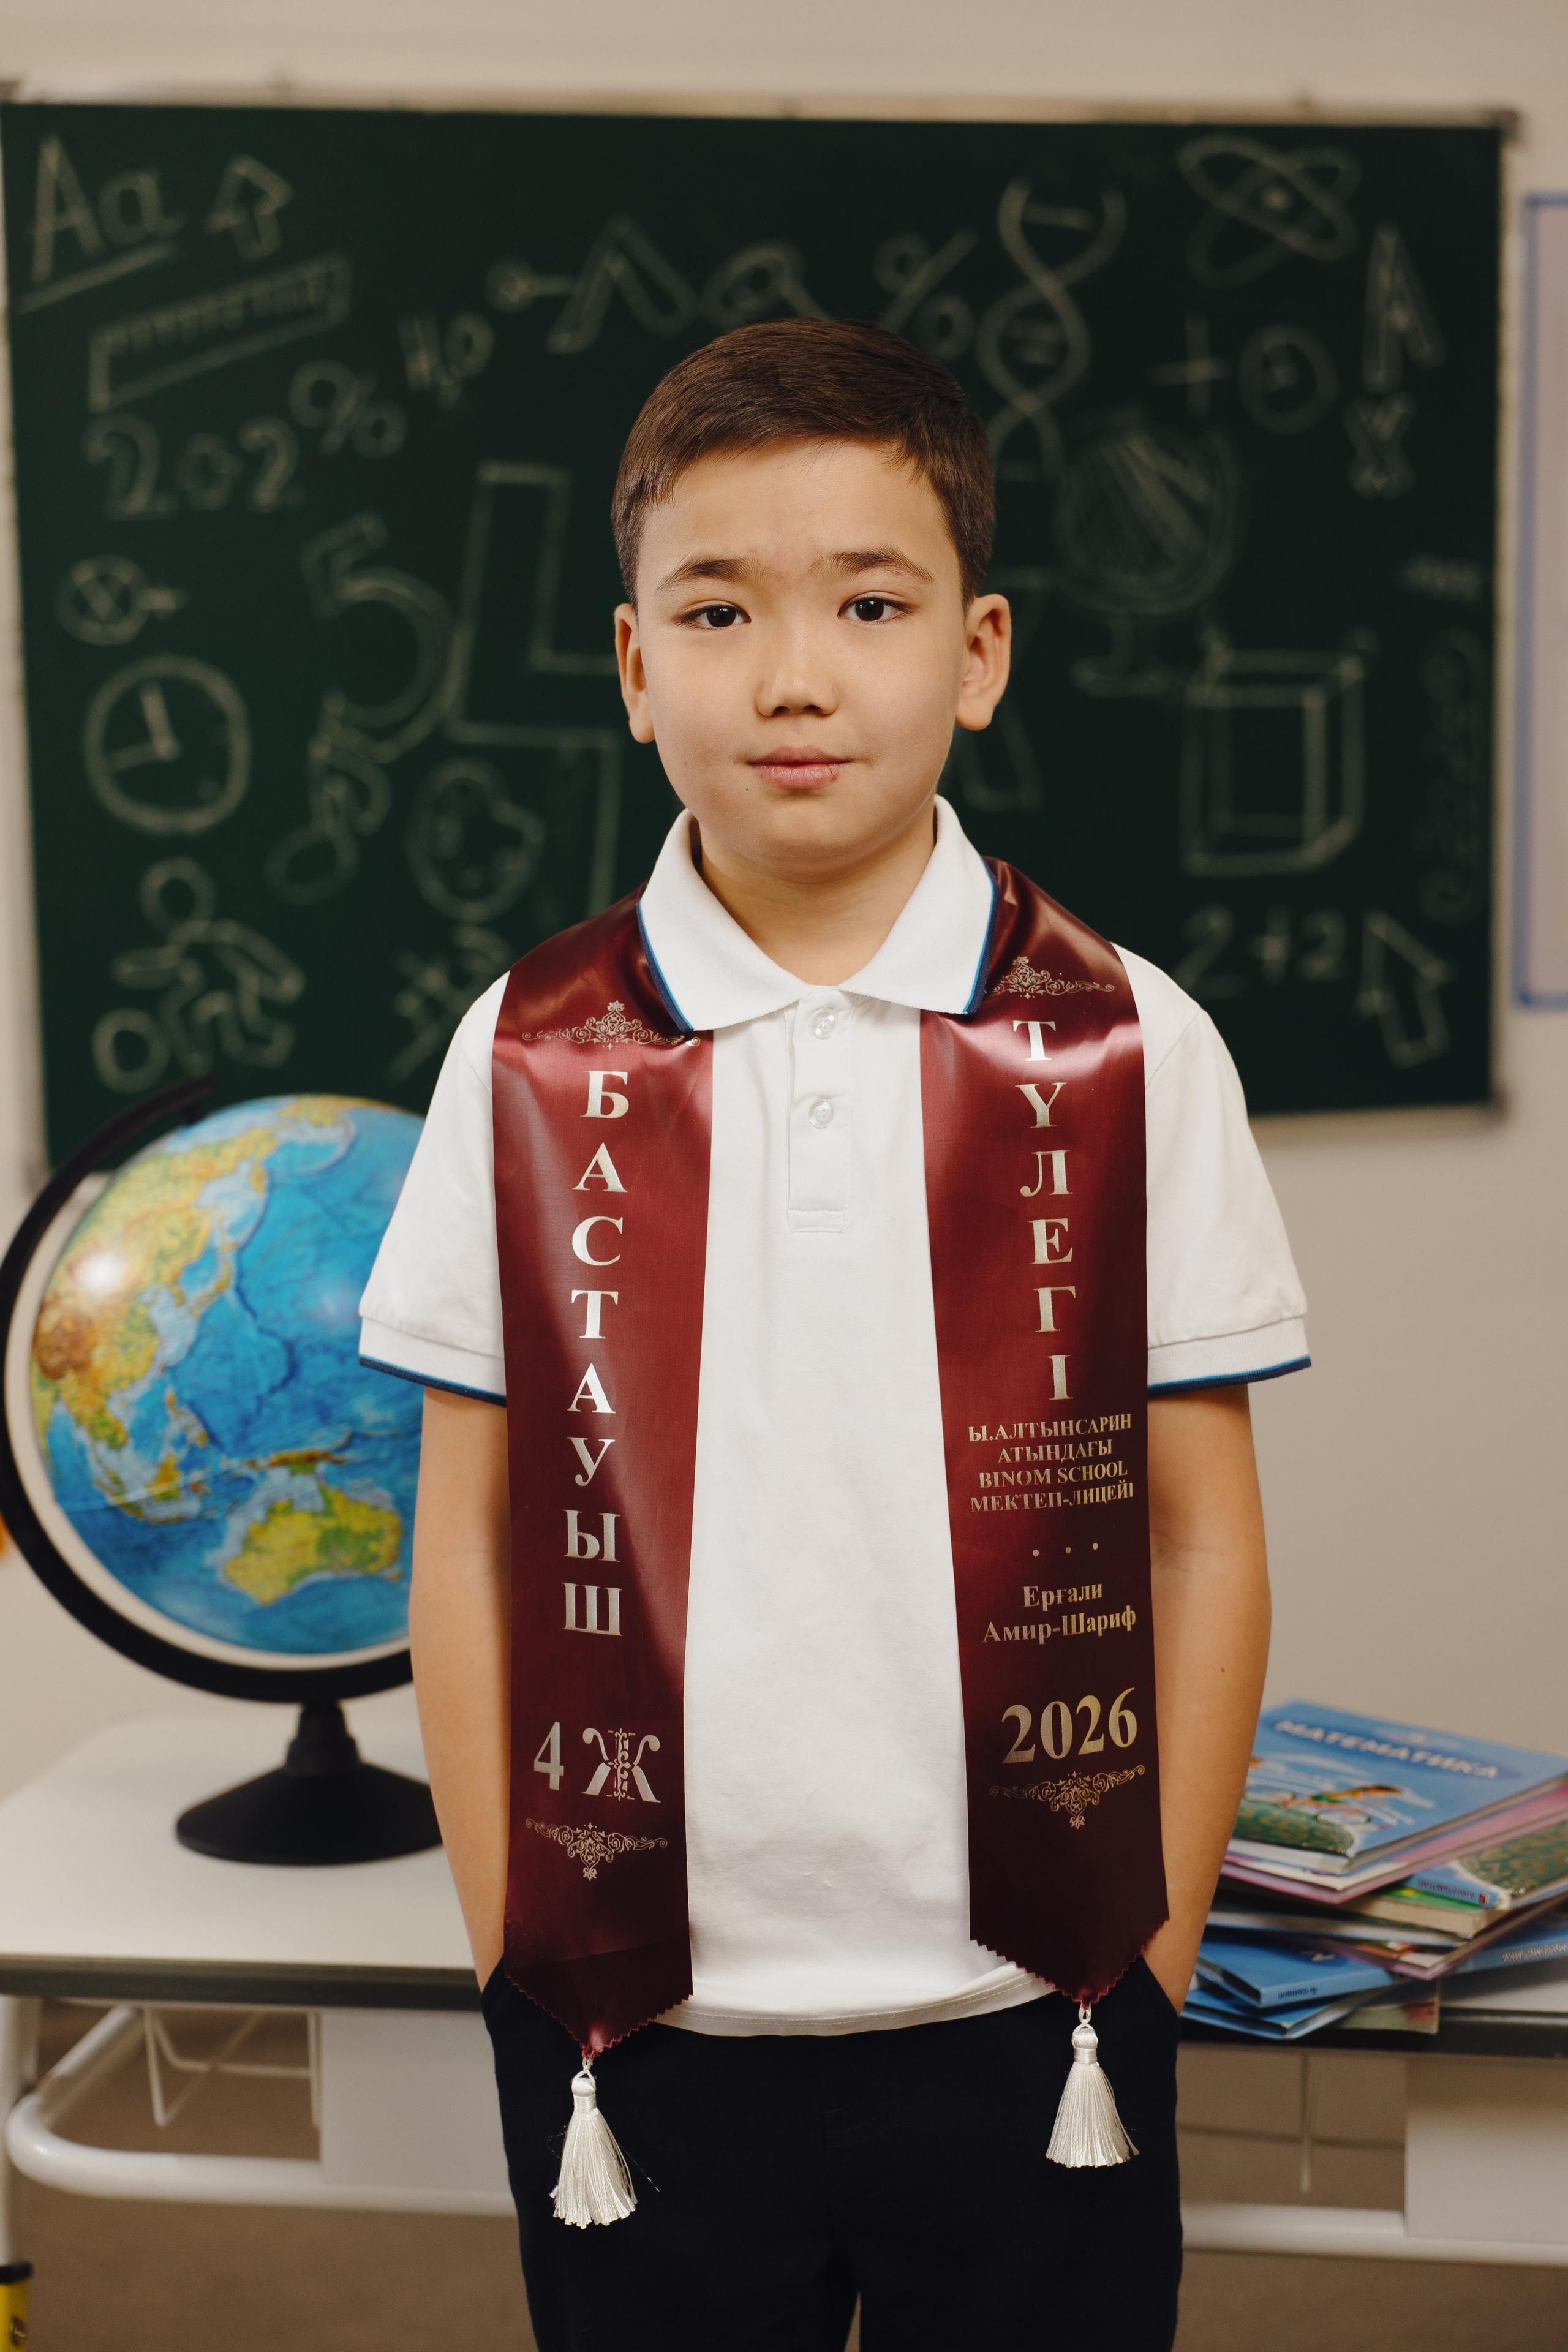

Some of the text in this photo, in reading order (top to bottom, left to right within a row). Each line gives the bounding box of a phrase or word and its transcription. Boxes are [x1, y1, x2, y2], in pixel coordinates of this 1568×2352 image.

[1012, 1020, 1076, 1401] ТҮЛЕГІ
[562, 1070, 630, 1636] БАСТАУЫШ
[968, 1413, 1131, 1442] Ы.АЛТЫНСАРИН
[998, 1439, 1113, 1464] АТЫНДАҒЫ
[978, 1460, 1128, 1488] BINOM SCHOOL
[971, 1479, 1134, 1513] МЕКТЕП-ЛИЦЕЙІ
[1022, 1583, 1103, 1611] Ерғали
[982, 1605, 1137, 1645] Амир-Шариф
[1001, 1687, 1137, 1764] 2026
[533, 1721, 661, 1803] 4 Ж
